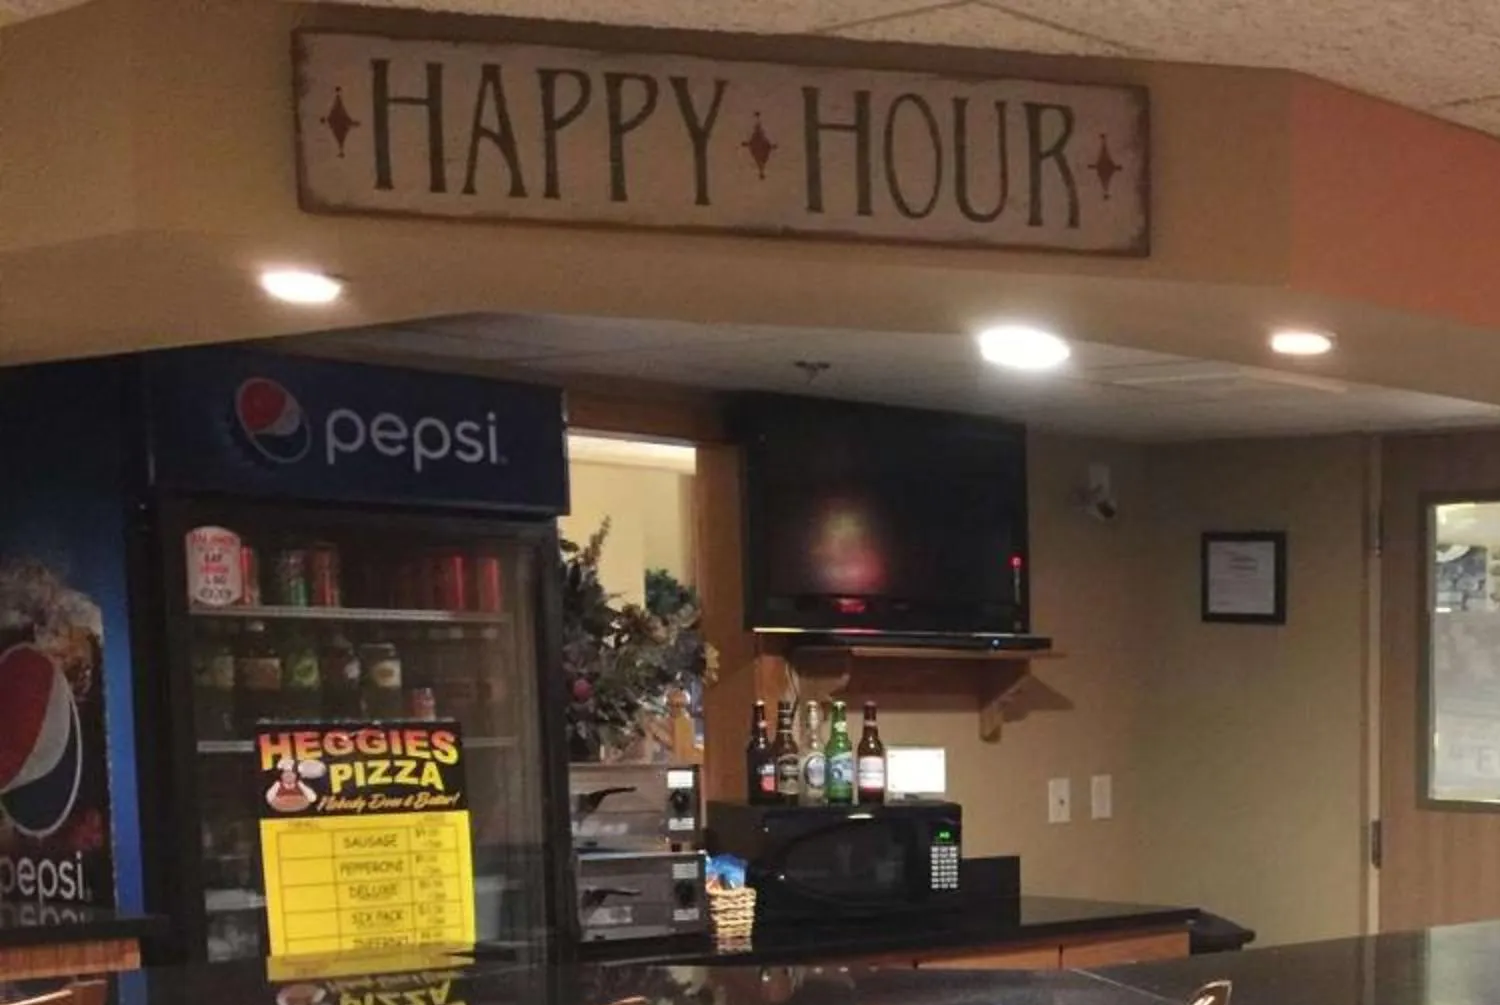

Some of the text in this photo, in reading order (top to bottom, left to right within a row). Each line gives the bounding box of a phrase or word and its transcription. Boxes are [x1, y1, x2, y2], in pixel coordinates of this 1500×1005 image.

[369, 57, 1083, 231] HAPPY HOUR
[325, 398, 498, 474] pepsi
[256, 727, 460, 772] HEGGIES
[328, 758, 445, 794] PIZZA
[342, 832, 400, 850] SAUSAGE
